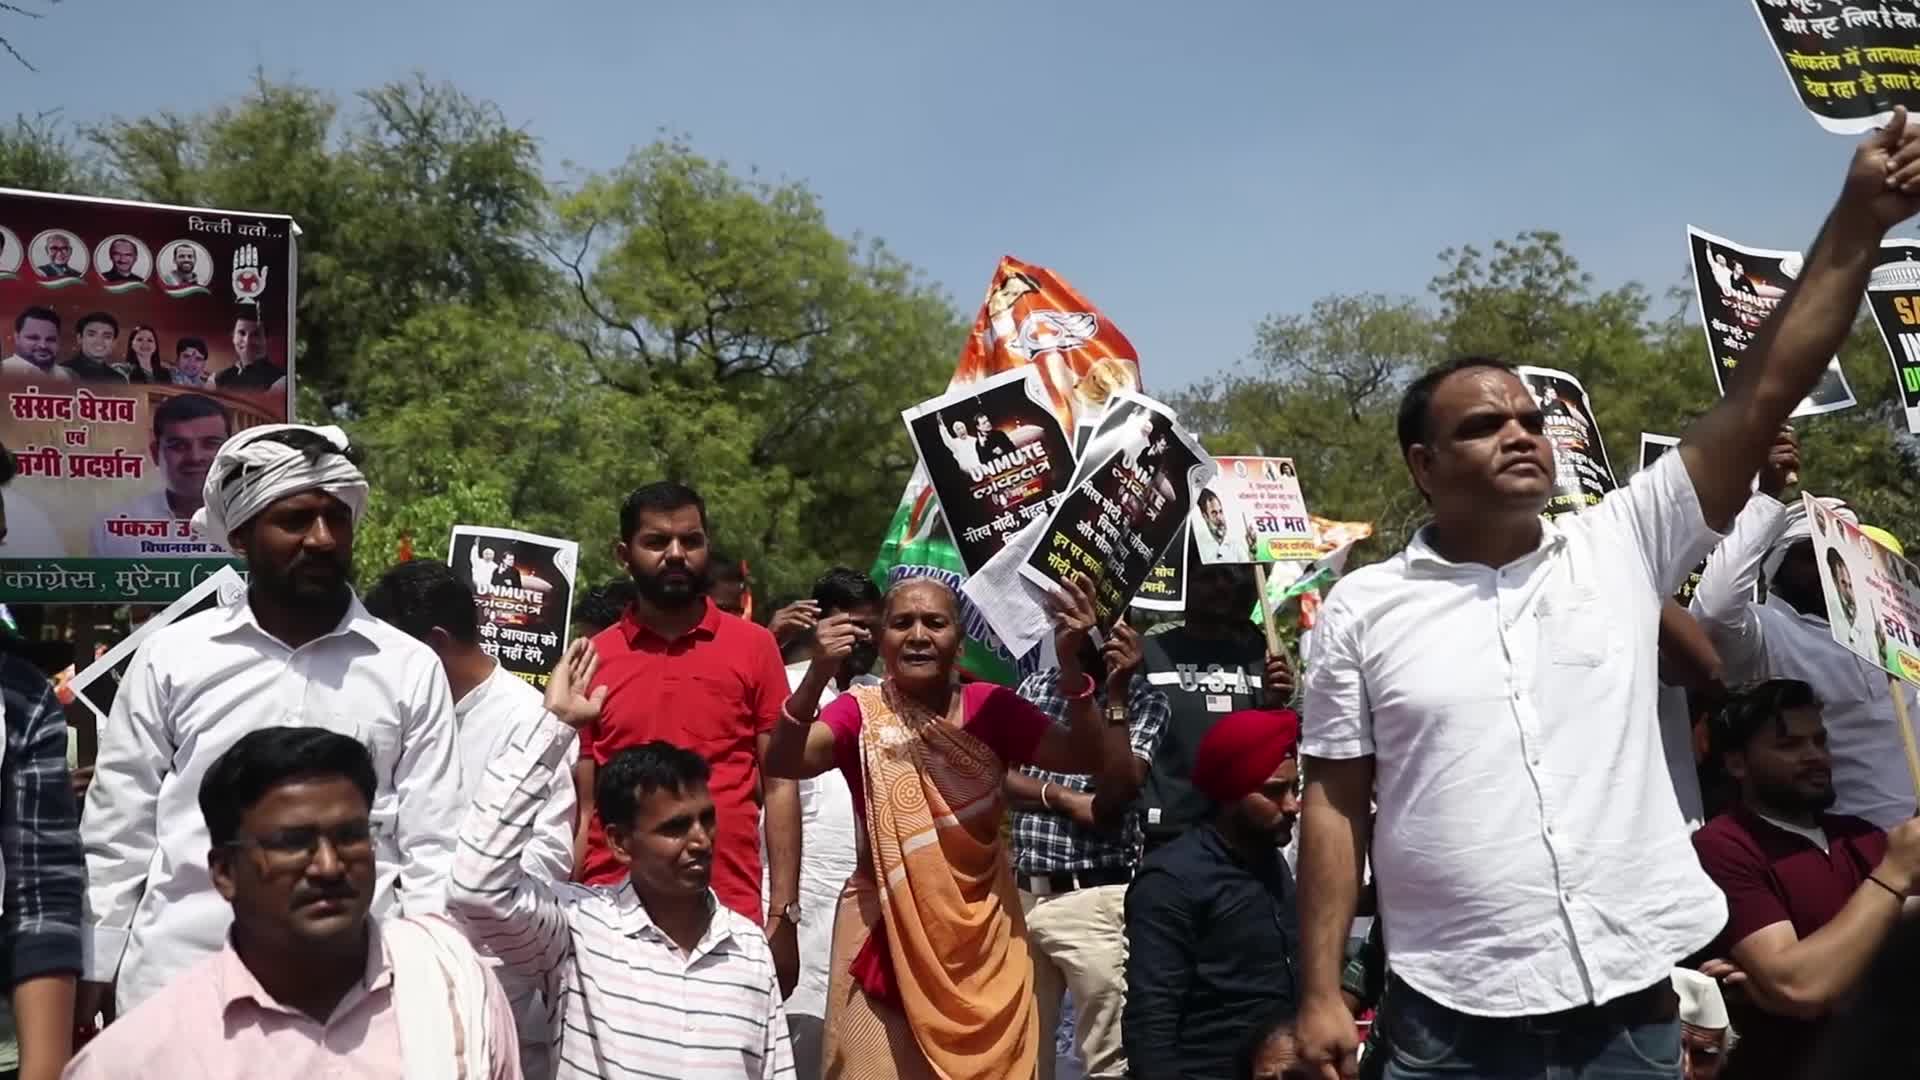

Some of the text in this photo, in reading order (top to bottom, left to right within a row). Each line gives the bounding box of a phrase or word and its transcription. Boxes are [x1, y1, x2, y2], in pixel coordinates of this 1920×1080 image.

[1781, 12, 1809, 34] और
[1808, 16, 1840, 39] लूट
[1840, 6, 1881, 28] लिए
[1842, 46, 1861, 66] में
[1862, 45, 1920, 66] तानाशाह
[1803, 75, 1829, 97] देख
[1829, 80, 1857, 99] रहा
[1859, 69, 1877, 94] है
[1877, 74, 1909, 90] सारा
[188, 216, 232, 235] दिल्ली
[10, 386, 137, 424] संसद घेराव
[65, 426, 88, 445] एवं
[68, 448, 144, 479] प्रदर्शन
[970, 441, 1046, 482] UNMUTE
[1080, 480, 1103, 504] नीरव
[107, 515, 169, 538] पंकज
[962, 524, 992, 543] नीरव
[991, 511, 1020, 532] मोदी,
[1076, 519, 1095, 541] और
[1254, 511, 1306, 533] डरो मत
[1053, 531, 1071, 549] इन
[1070, 543, 1083, 560] पर
[1047, 552, 1071, 575] मोदी
[1154, 565, 1176, 577] सोच
[116, 564, 181, 597] मुरैना
[477, 584, 543, 604] UNMUTE
[480, 621, 558, 647] की आवाज को
[502, 643, 523, 661] नहीं
[525, 646, 545, 666] देंगे,
